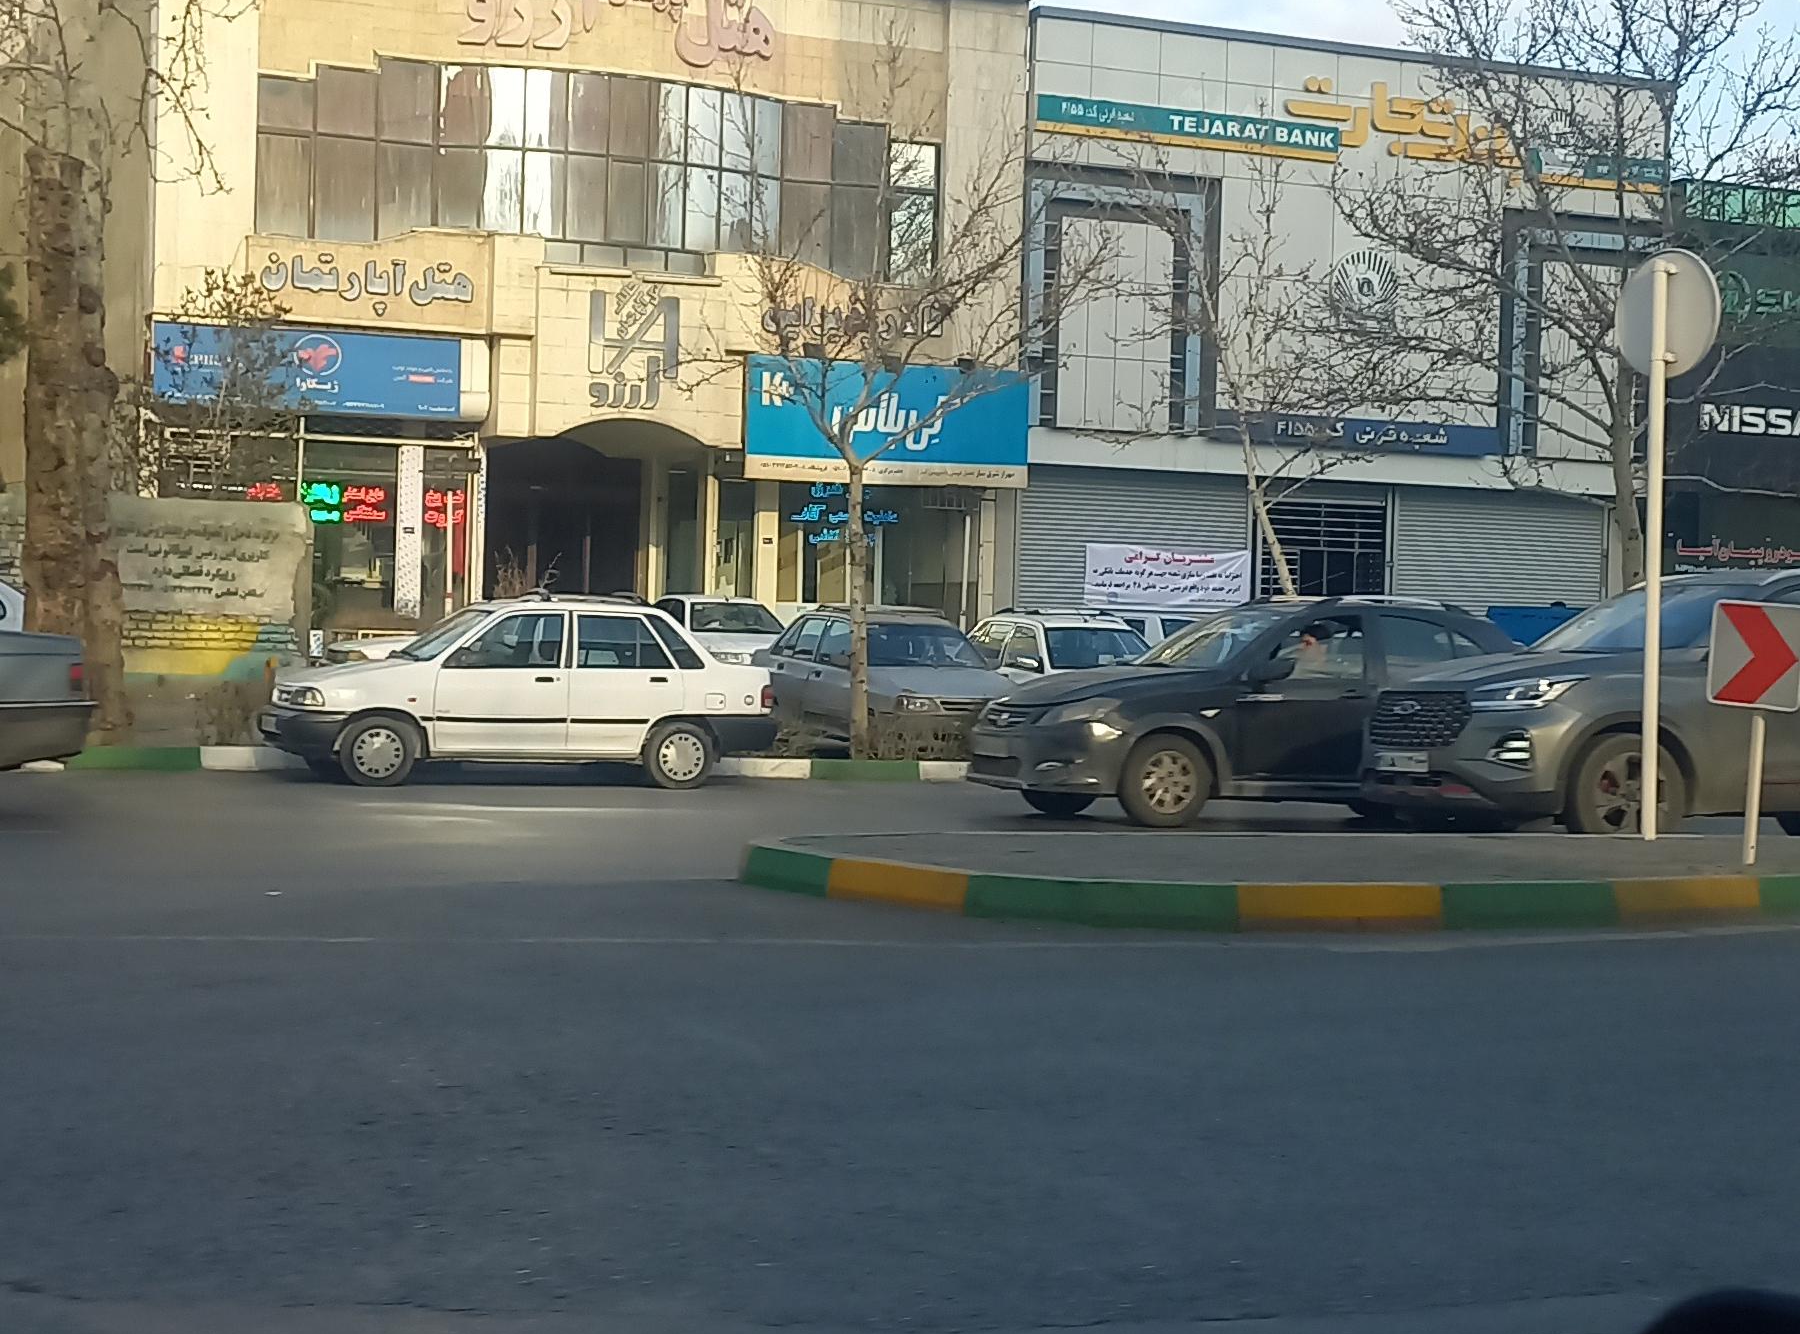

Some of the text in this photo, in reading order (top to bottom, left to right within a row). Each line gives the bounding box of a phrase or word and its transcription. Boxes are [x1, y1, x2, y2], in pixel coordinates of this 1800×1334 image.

[1169, 114, 1335, 149] TEJARAT BANK
[1284, 75, 1457, 157] تجارت
[260, 252, 475, 318] هتل آپارتمان
[1355, 425, 1398, 445] قرنی
[1400, 427, 1448, 450] شعبه
